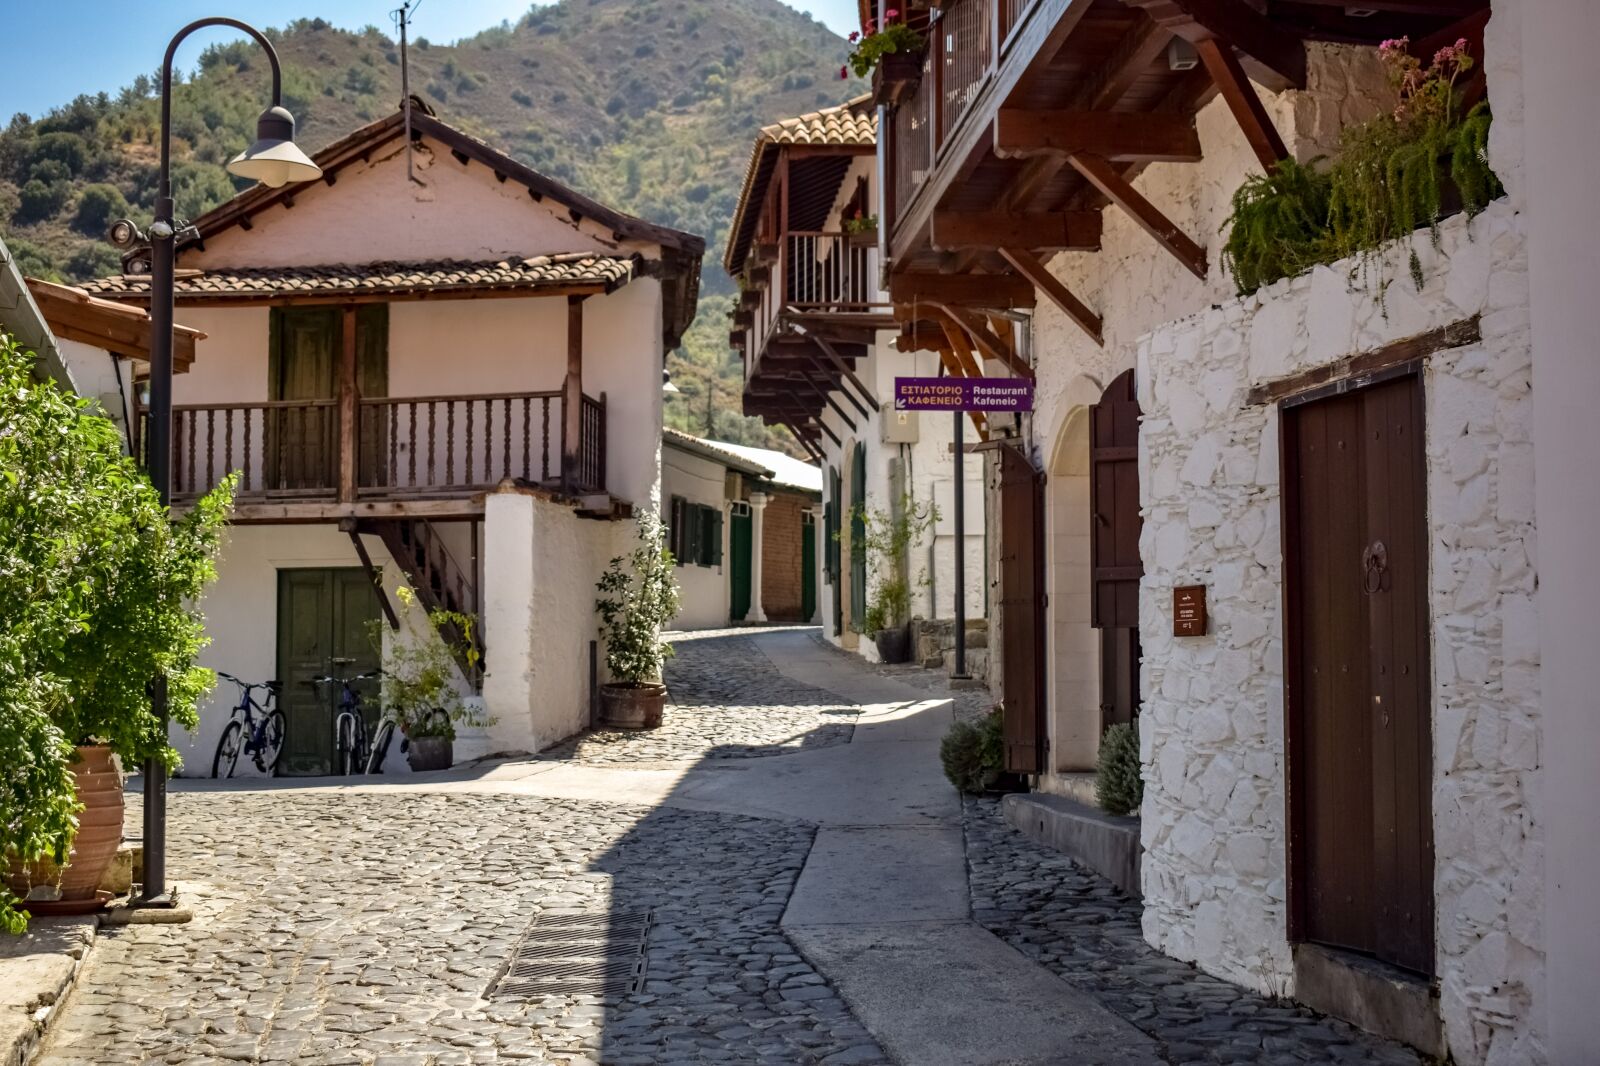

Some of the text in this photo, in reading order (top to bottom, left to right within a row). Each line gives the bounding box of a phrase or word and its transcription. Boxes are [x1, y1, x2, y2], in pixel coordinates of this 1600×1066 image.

[901, 386, 962, 395] ΕΣΤΙΑΤΟΡΙΟ
[973, 386, 1027, 395] Restaurant
[908, 396, 962, 405] ΚΑΦΕΝΕΙΟ
[973, 397, 1017, 405] Kafeneio
